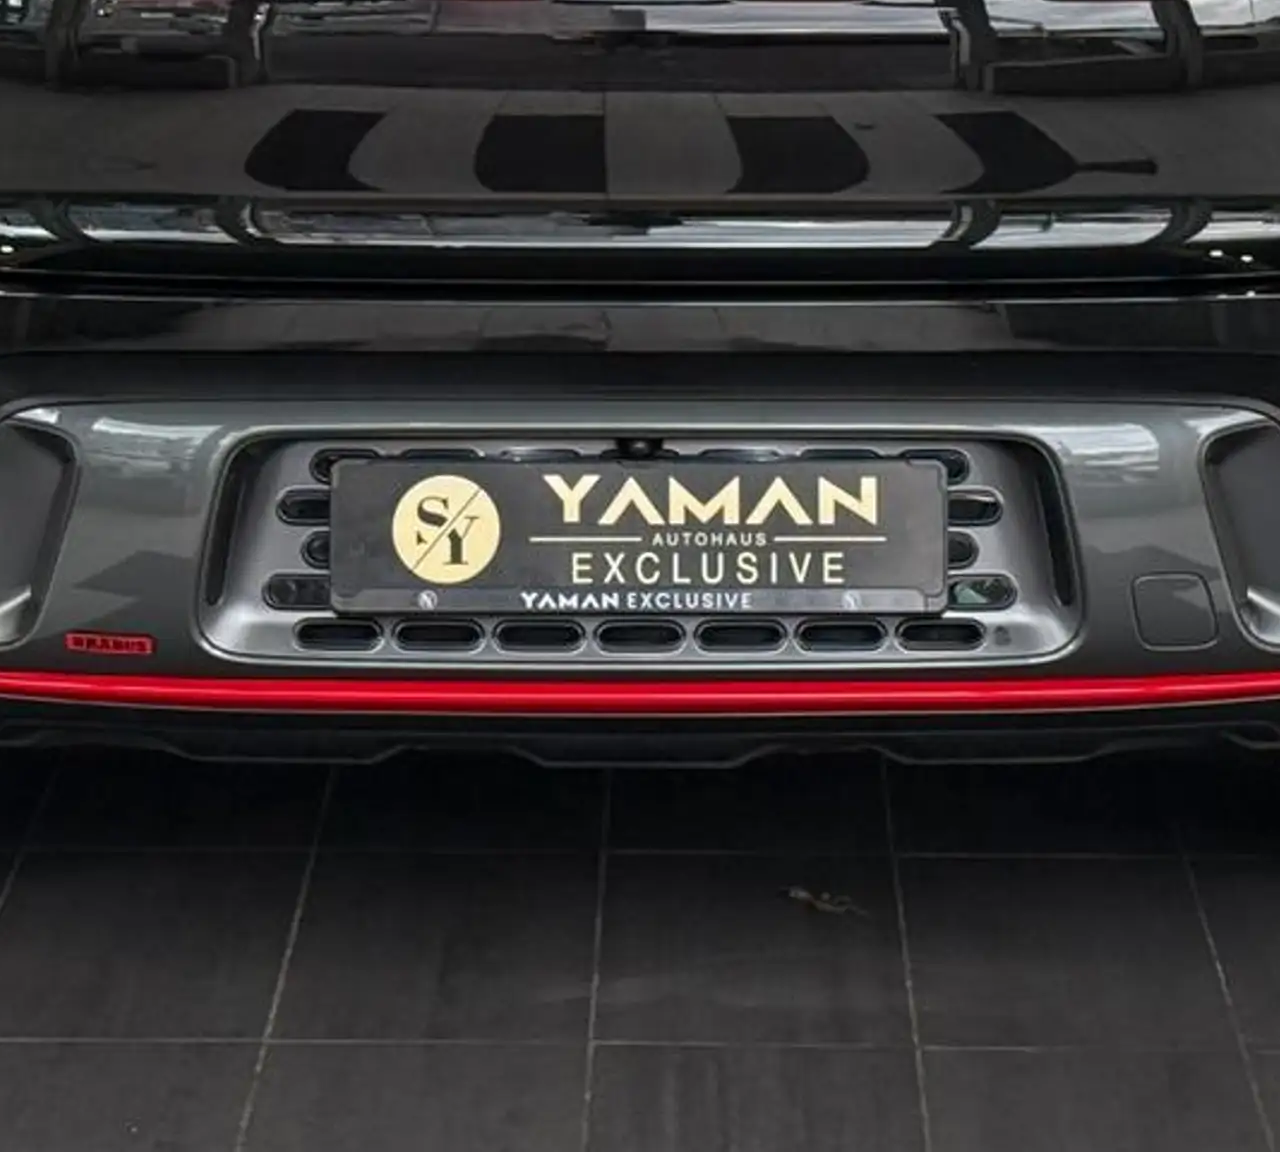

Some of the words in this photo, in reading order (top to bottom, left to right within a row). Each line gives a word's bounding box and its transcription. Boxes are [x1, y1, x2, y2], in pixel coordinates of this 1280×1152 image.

[542, 474, 879, 525] YAMAN
[651, 532, 768, 547] AUTOHAUS
[571, 552, 845, 584] EXCLUSIVE
[520, 591, 620, 610] YAMAN
[626, 591, 753, 609] EXCLUSIVE
